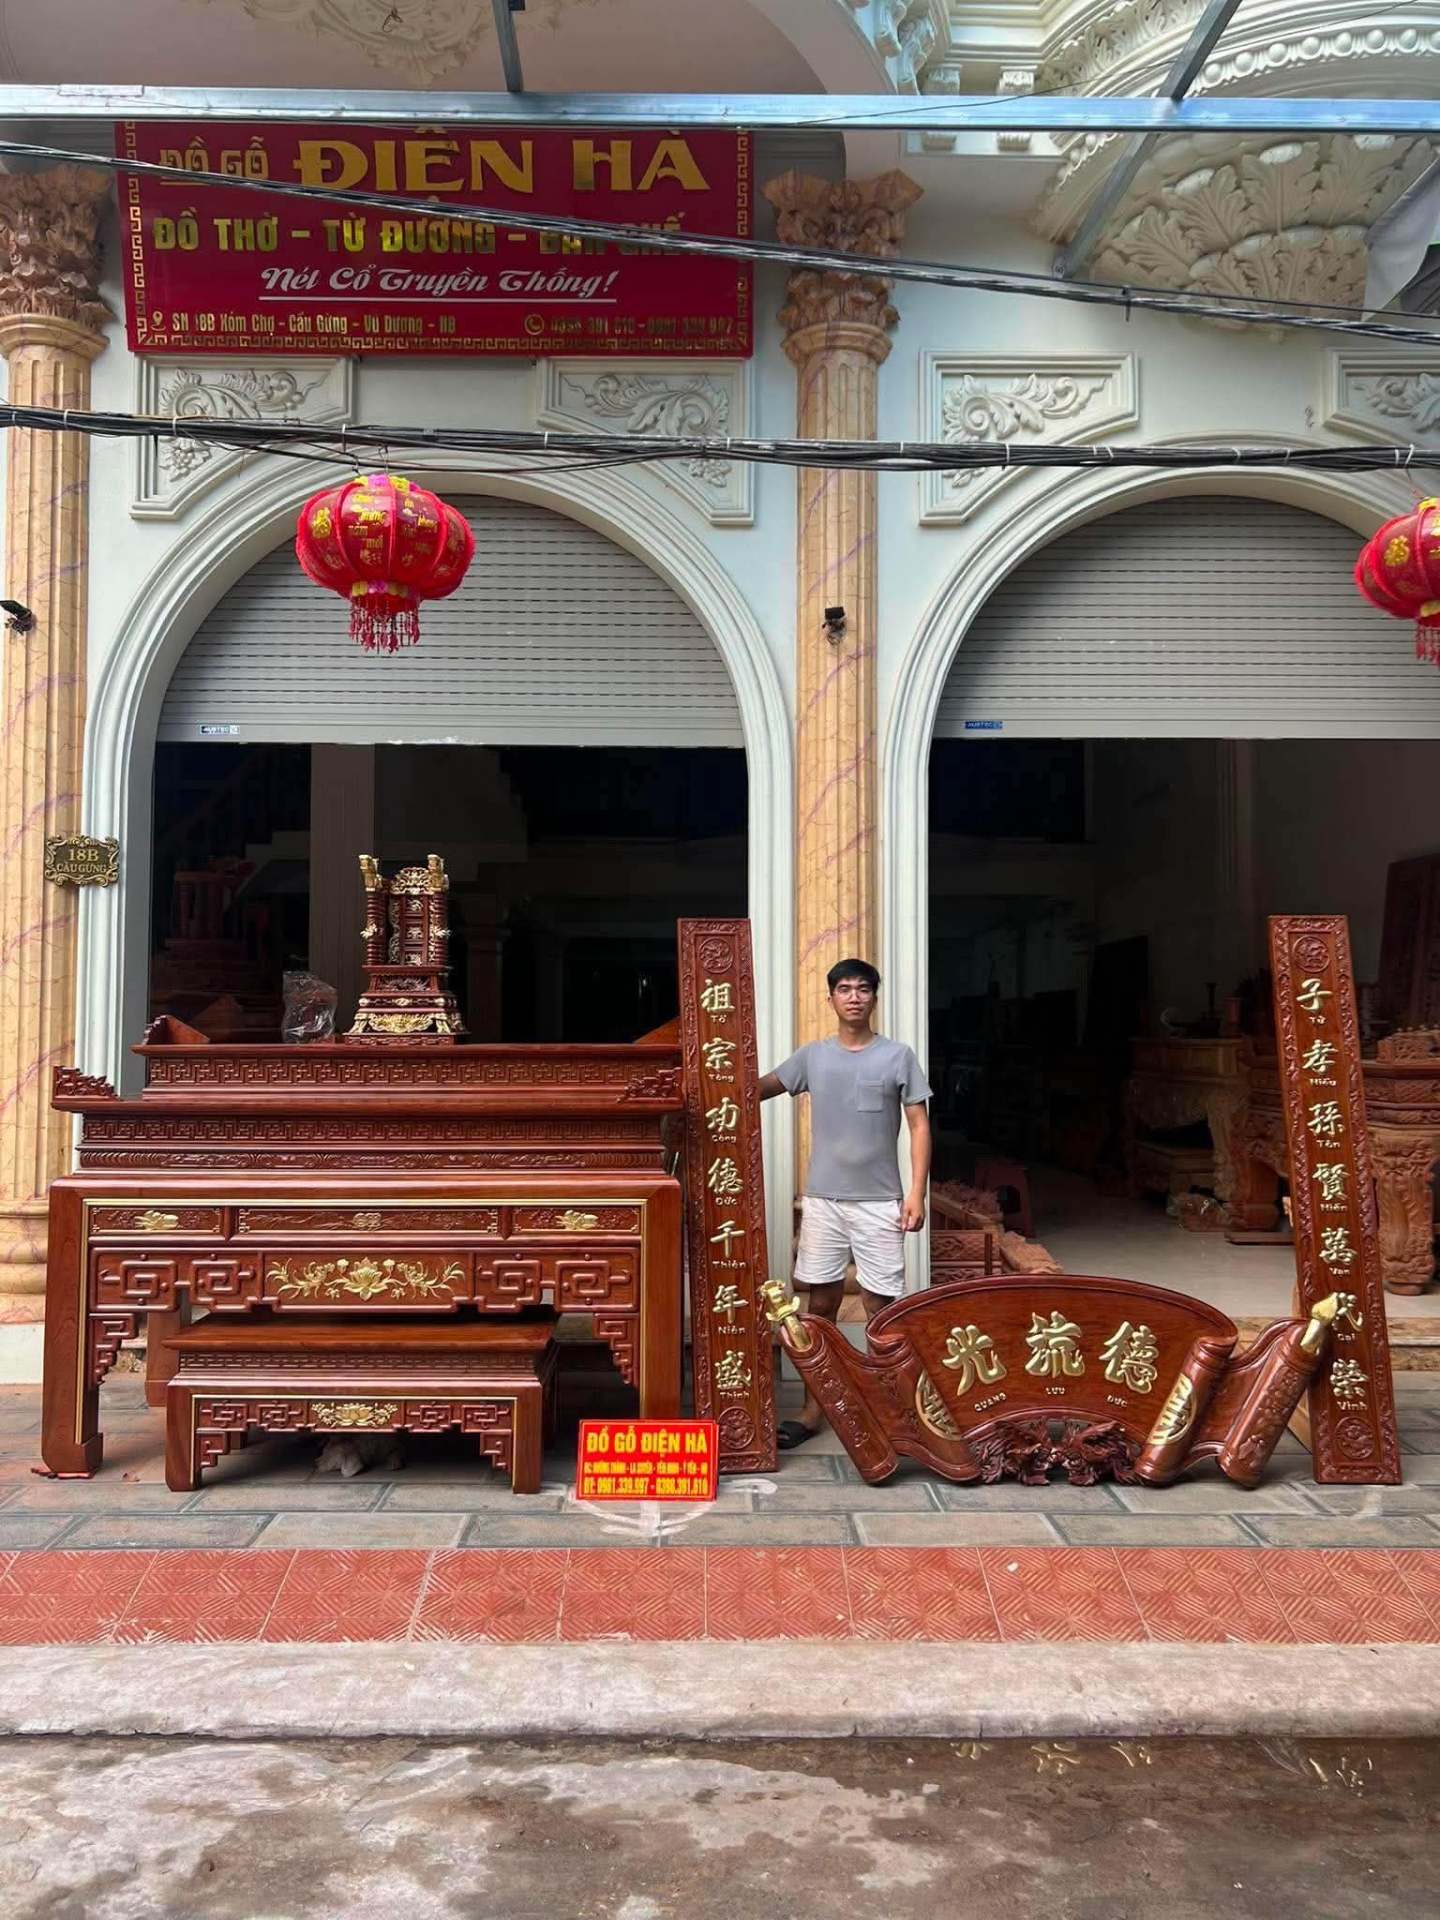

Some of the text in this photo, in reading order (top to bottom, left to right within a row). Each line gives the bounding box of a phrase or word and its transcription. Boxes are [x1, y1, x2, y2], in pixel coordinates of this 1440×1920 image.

[571, 128, 712, 191] HÀ
[153, 206, 199, 251] ĐỒ
[323, 211, 367, 252] TỪ
[328, 263, 377, 292] Cổ
[378, 266, 489, 297] Truyền
[171, 311, 189, 332] SN
[220, 311, 247, 332] Xóm
[251, 313, 275, 336] Chợ
[69, 848, 99, 862] 18B
[613, 1424, 637, 1454] GỖ
[640, 1428, 680, 1458] ĐIỆN
